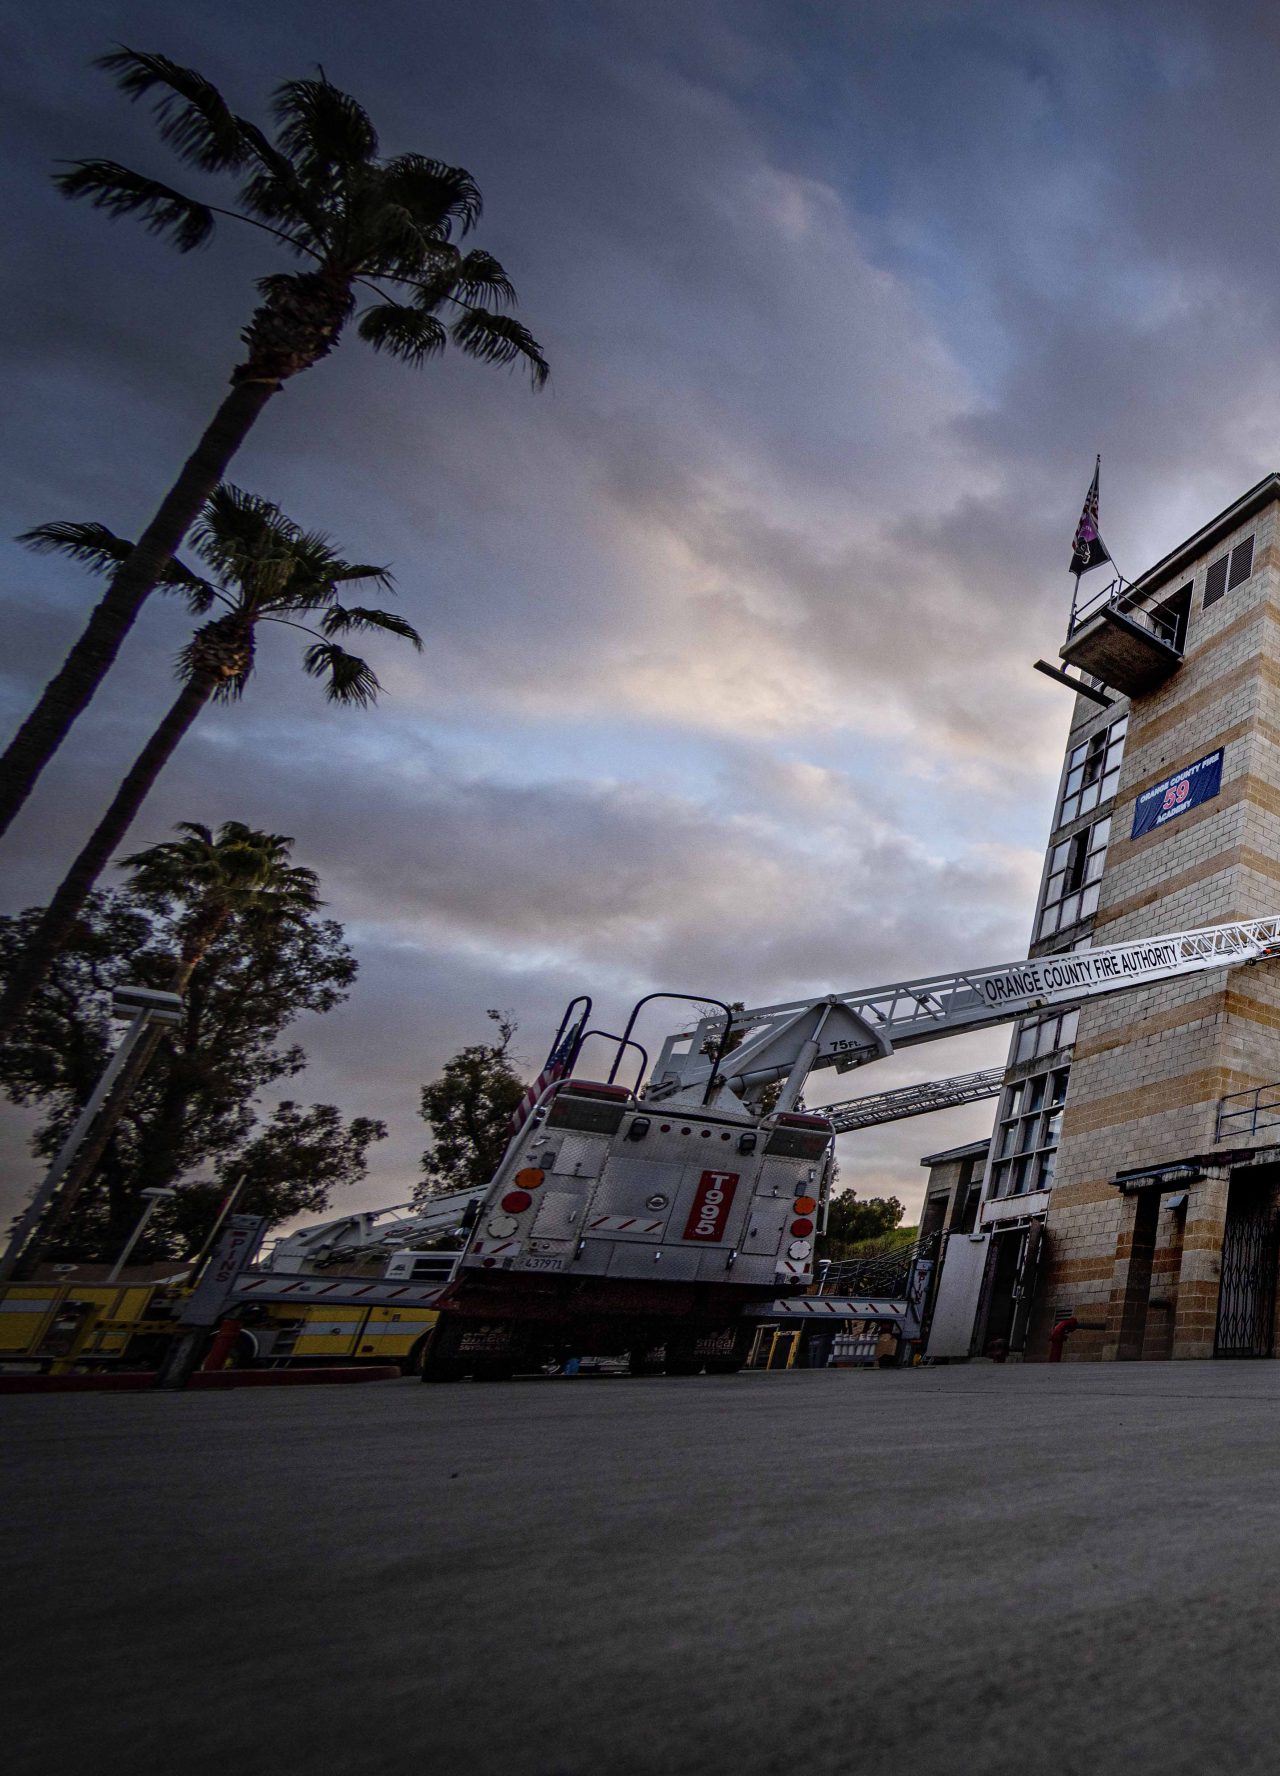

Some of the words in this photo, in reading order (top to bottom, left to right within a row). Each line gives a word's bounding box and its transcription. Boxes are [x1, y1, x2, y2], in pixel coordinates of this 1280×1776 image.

[1140, 781, 1169, 804] ORANGE
[1169, 763, 1201, 787] COUNTY
[1201, 752, 1219, 769] FIRE
[1162, 779, 1190, 810] 59
[985, 971, 1043, 1001] ORANGE
[1043, 960, 1093, 988] COUNTY
[1093, 956, 1121, 978] FIRE
[1121, 944, 1178, 973] AUTHORITY
[695, 1174, 730, 1235] T995
